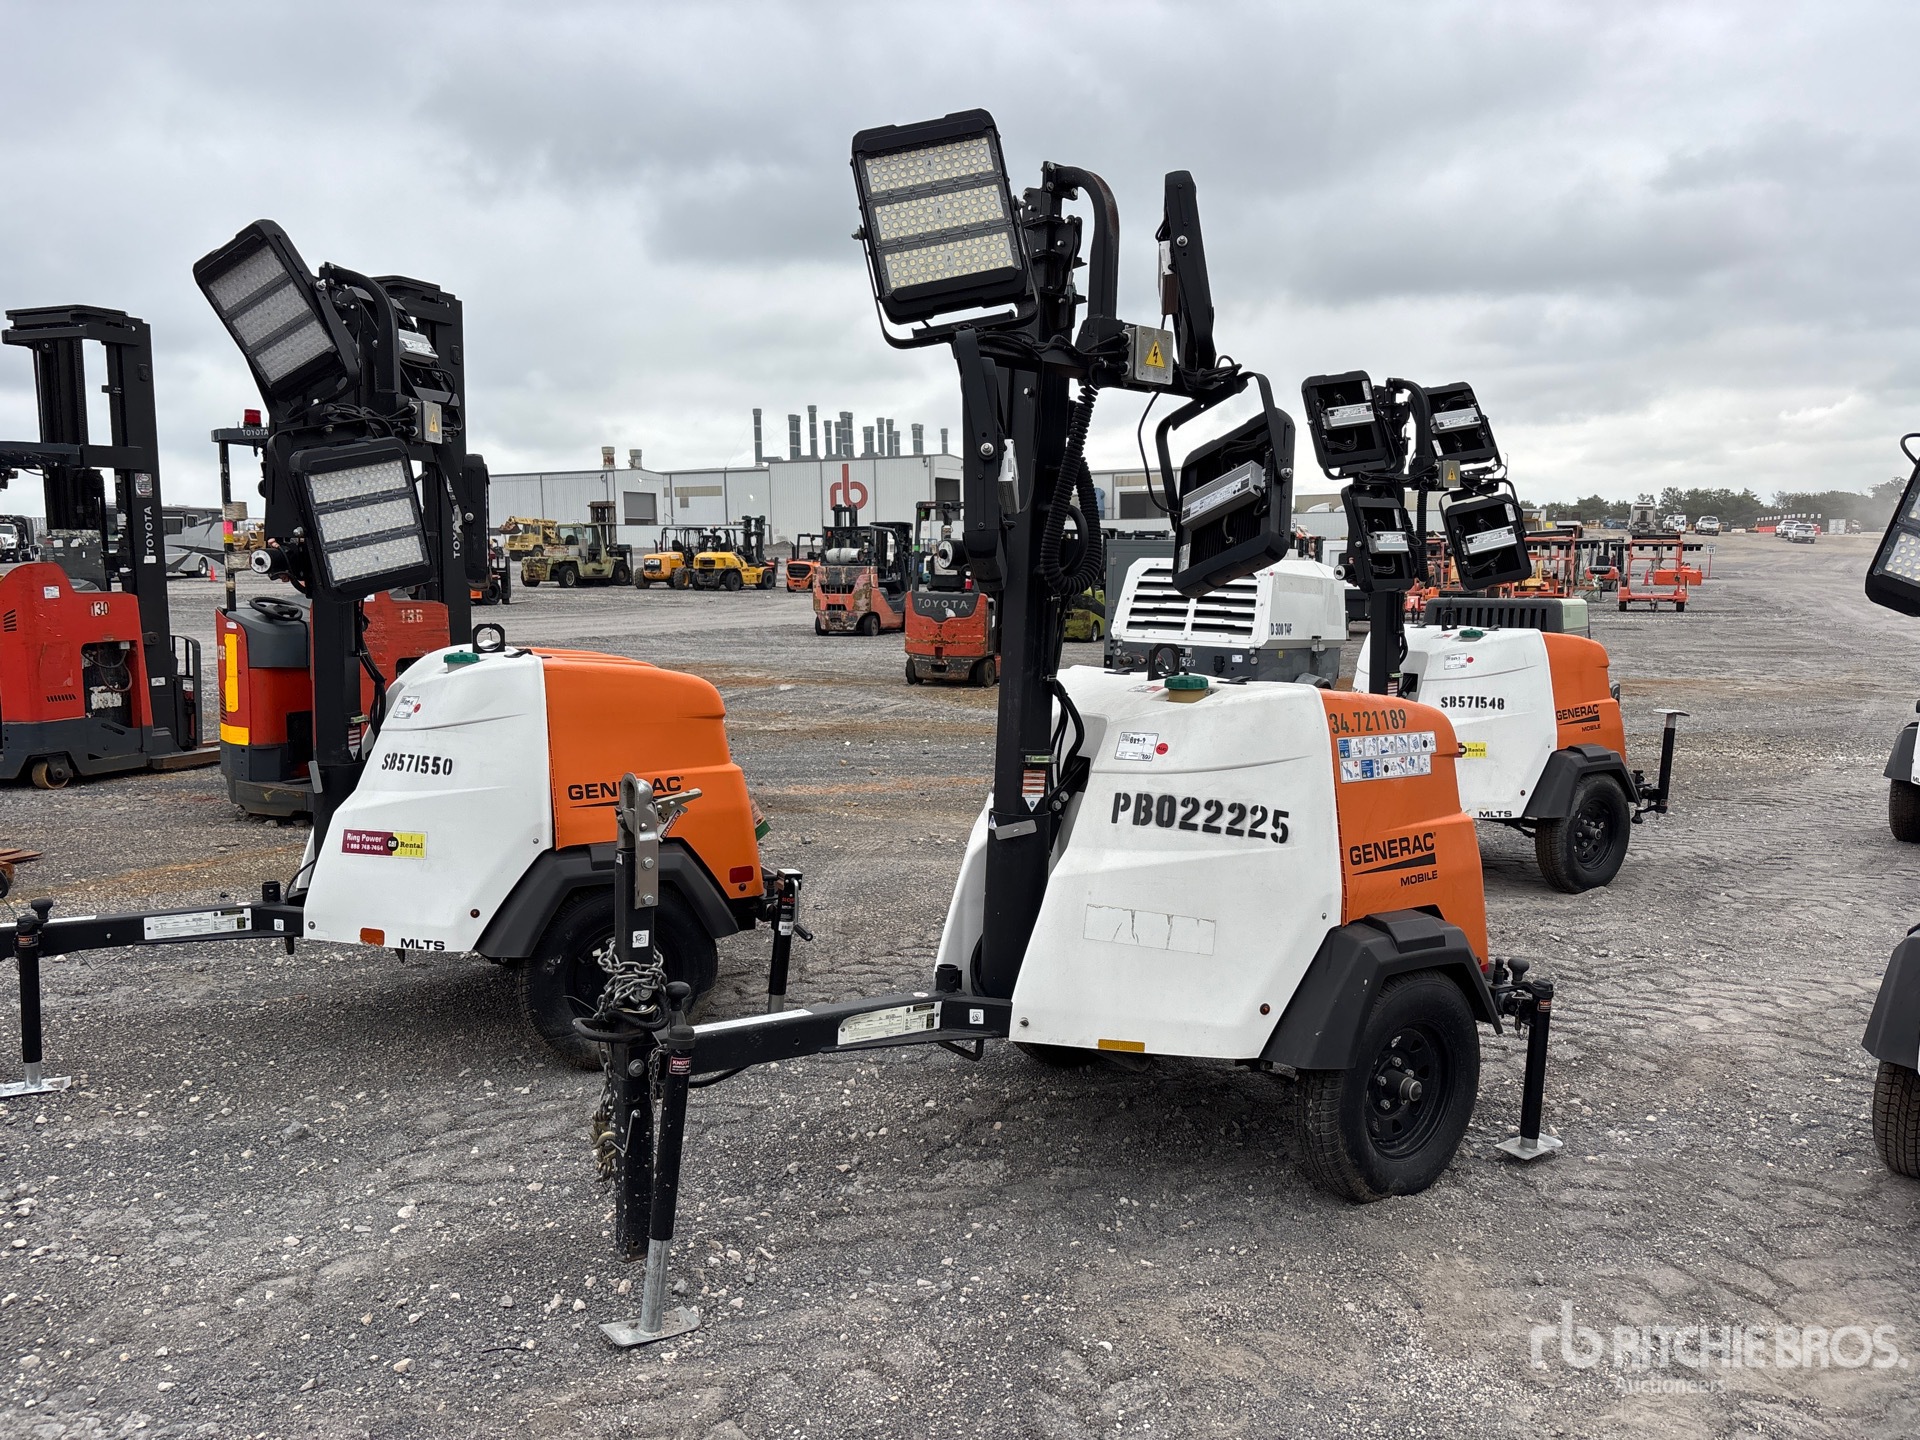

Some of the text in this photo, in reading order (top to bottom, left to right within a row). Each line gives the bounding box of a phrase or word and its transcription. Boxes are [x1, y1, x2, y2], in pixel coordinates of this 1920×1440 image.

[242, 429, 269, 437] TOYOTA
[830, 463, 868, 510] rb
[143, 506, 155, 555] TOYOTA
[917, 598, 969, 609] TOYOTA
[1270, 622, 1275, 636] D
[1440, 695, 1505, 711] SB571548
[1555, 703, 1599, 721] GENERAC
[1329, 708, 1407, 735] 34.721189
[1581, 724, 1601, 732] MOBILE
[381, 752, 453, 776] SB571550
[567, 776, 682, 801] GENAC
[1111, 792, 1290, 844] PB022225
[1478, 810, 1513, 818] MLTS
[346, 832, 382, 843] Ring Power
[399, 841, 423, 849] Rental
[1349, 832, 1436, 866] GENERAC
[1400, 869, 1438, 887] MOBILE
[400, 937, 445, 951] MLTS
